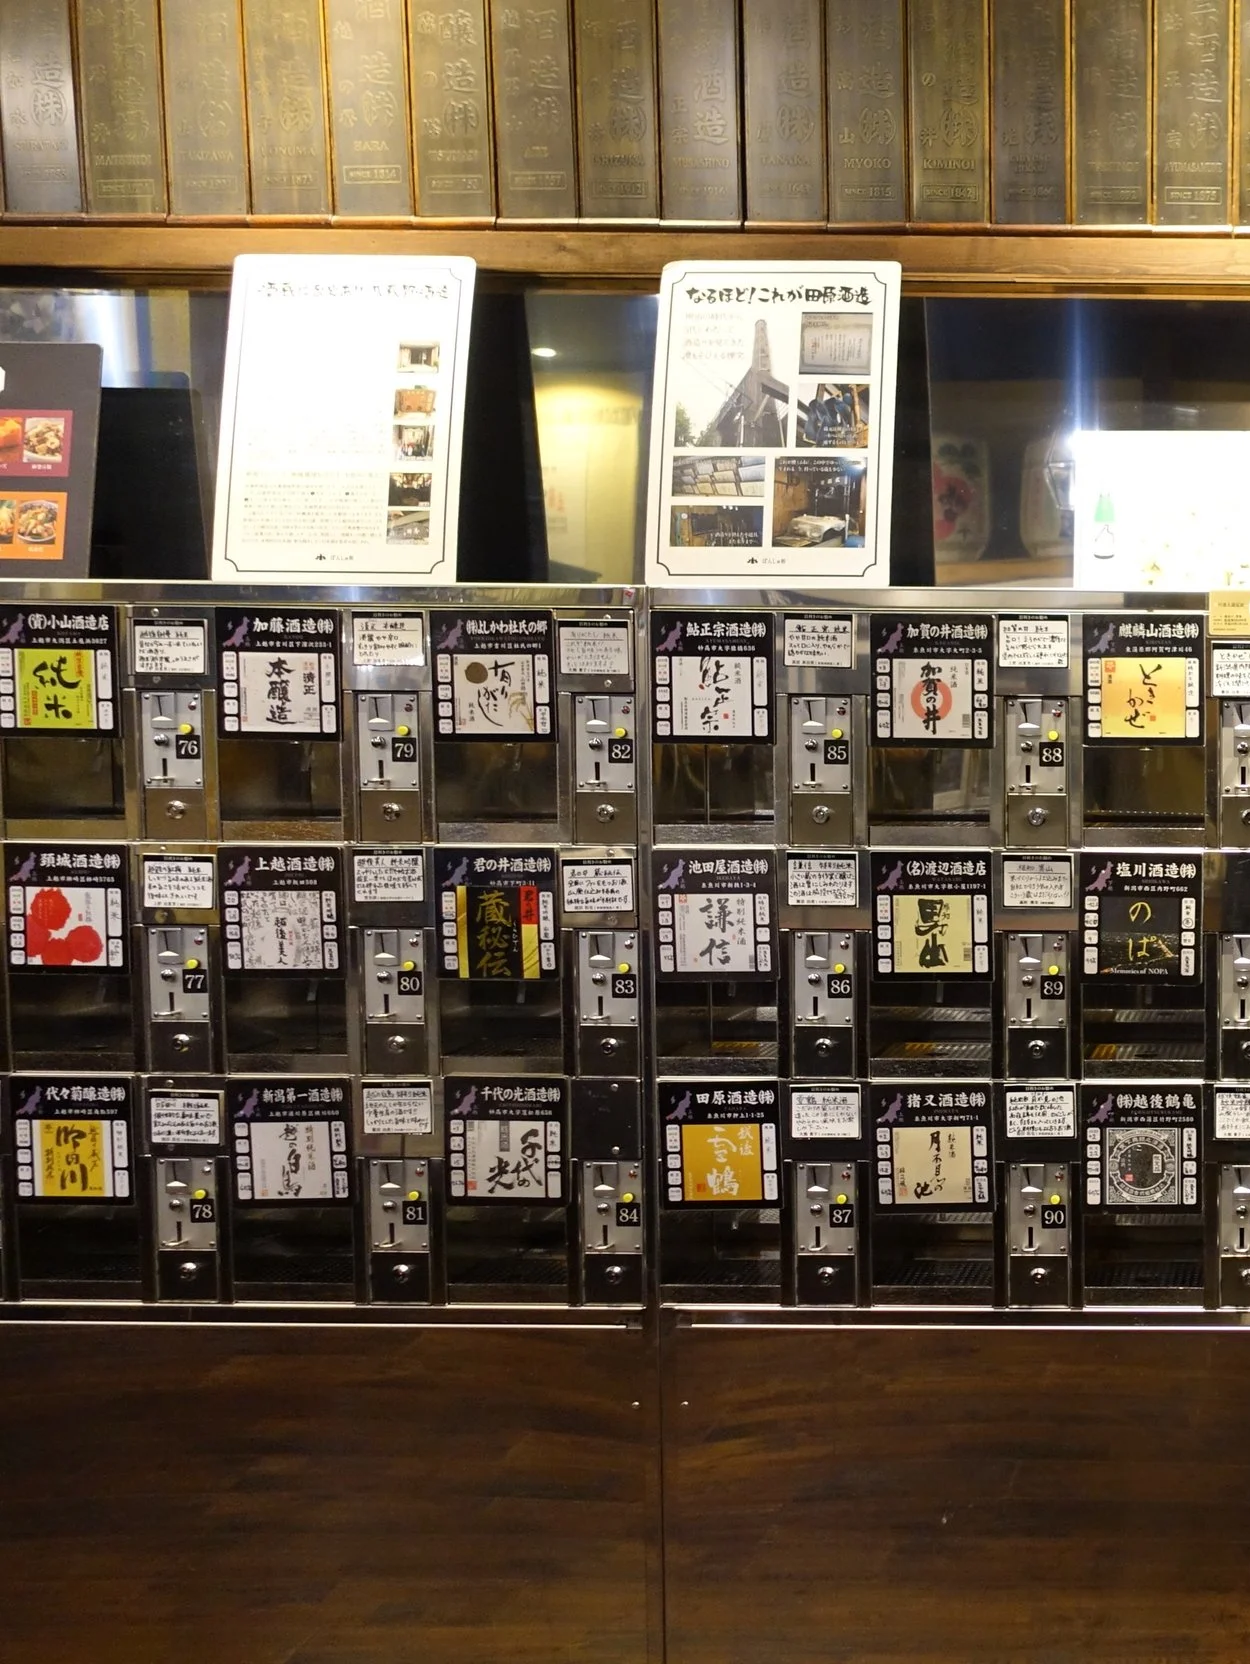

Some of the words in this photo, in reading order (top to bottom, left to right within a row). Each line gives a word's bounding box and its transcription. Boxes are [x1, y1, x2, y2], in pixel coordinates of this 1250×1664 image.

[843, 157, 892, 169] MYOKO
[923, 158, 975, 170] KIMINOI
[920, 662, 943, 735] 加賀の井
[179, 740, 198, 754] 76
[395, 743, 413, 757] 79
[612, 745, 630, 758] 82
[828, 746, 846, 760] 85
[1042, 748, 1062, 762] 88
[1111, 967, 1139, 975] Memories
[1148, 967, 1169, 975] NOPA
[182, 975, 204, 989] 77
[400, 977, 420, 991] 80
[615, 980, 634, 993] 83
[831, 980, 850, 993] 86
[1044, 981, 1063, 995] 89
[190, 1205, 212, 1218] 78
[406, 1207, 423, 1220] 81
[619, 1208, 638, 1222] 84
[833, 1210, 851, 1223] 87
[1045, 1211, 1064, 1224] 90
